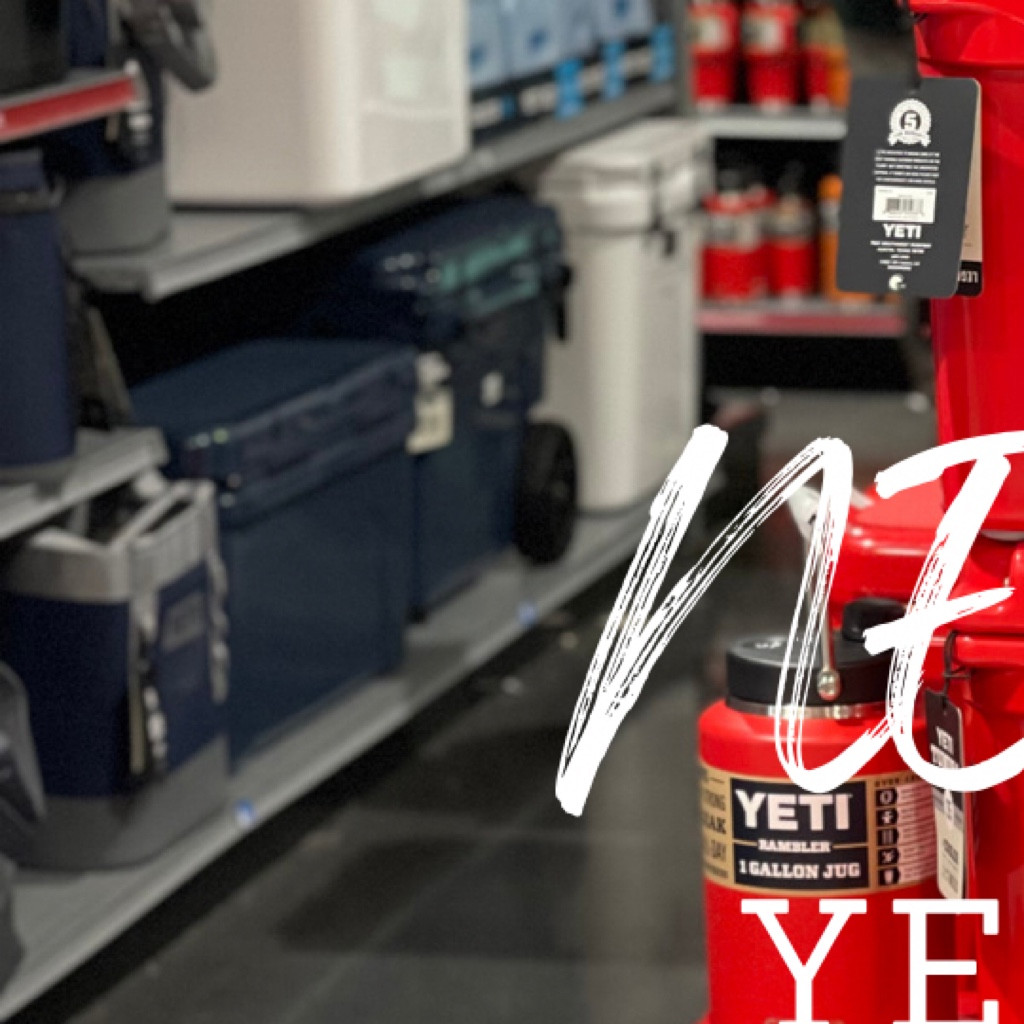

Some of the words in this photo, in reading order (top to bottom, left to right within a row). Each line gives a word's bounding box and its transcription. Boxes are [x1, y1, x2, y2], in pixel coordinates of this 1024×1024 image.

[882, 223, 922, 239] YETI
[735, 789, 852, 831] YETI
[758, 838, 831, 853] RAMBLER
[738, 859, 748, 874] 1
[748, 860, 819, 879] GALLON
[822, 862, 861, 879] JUG
